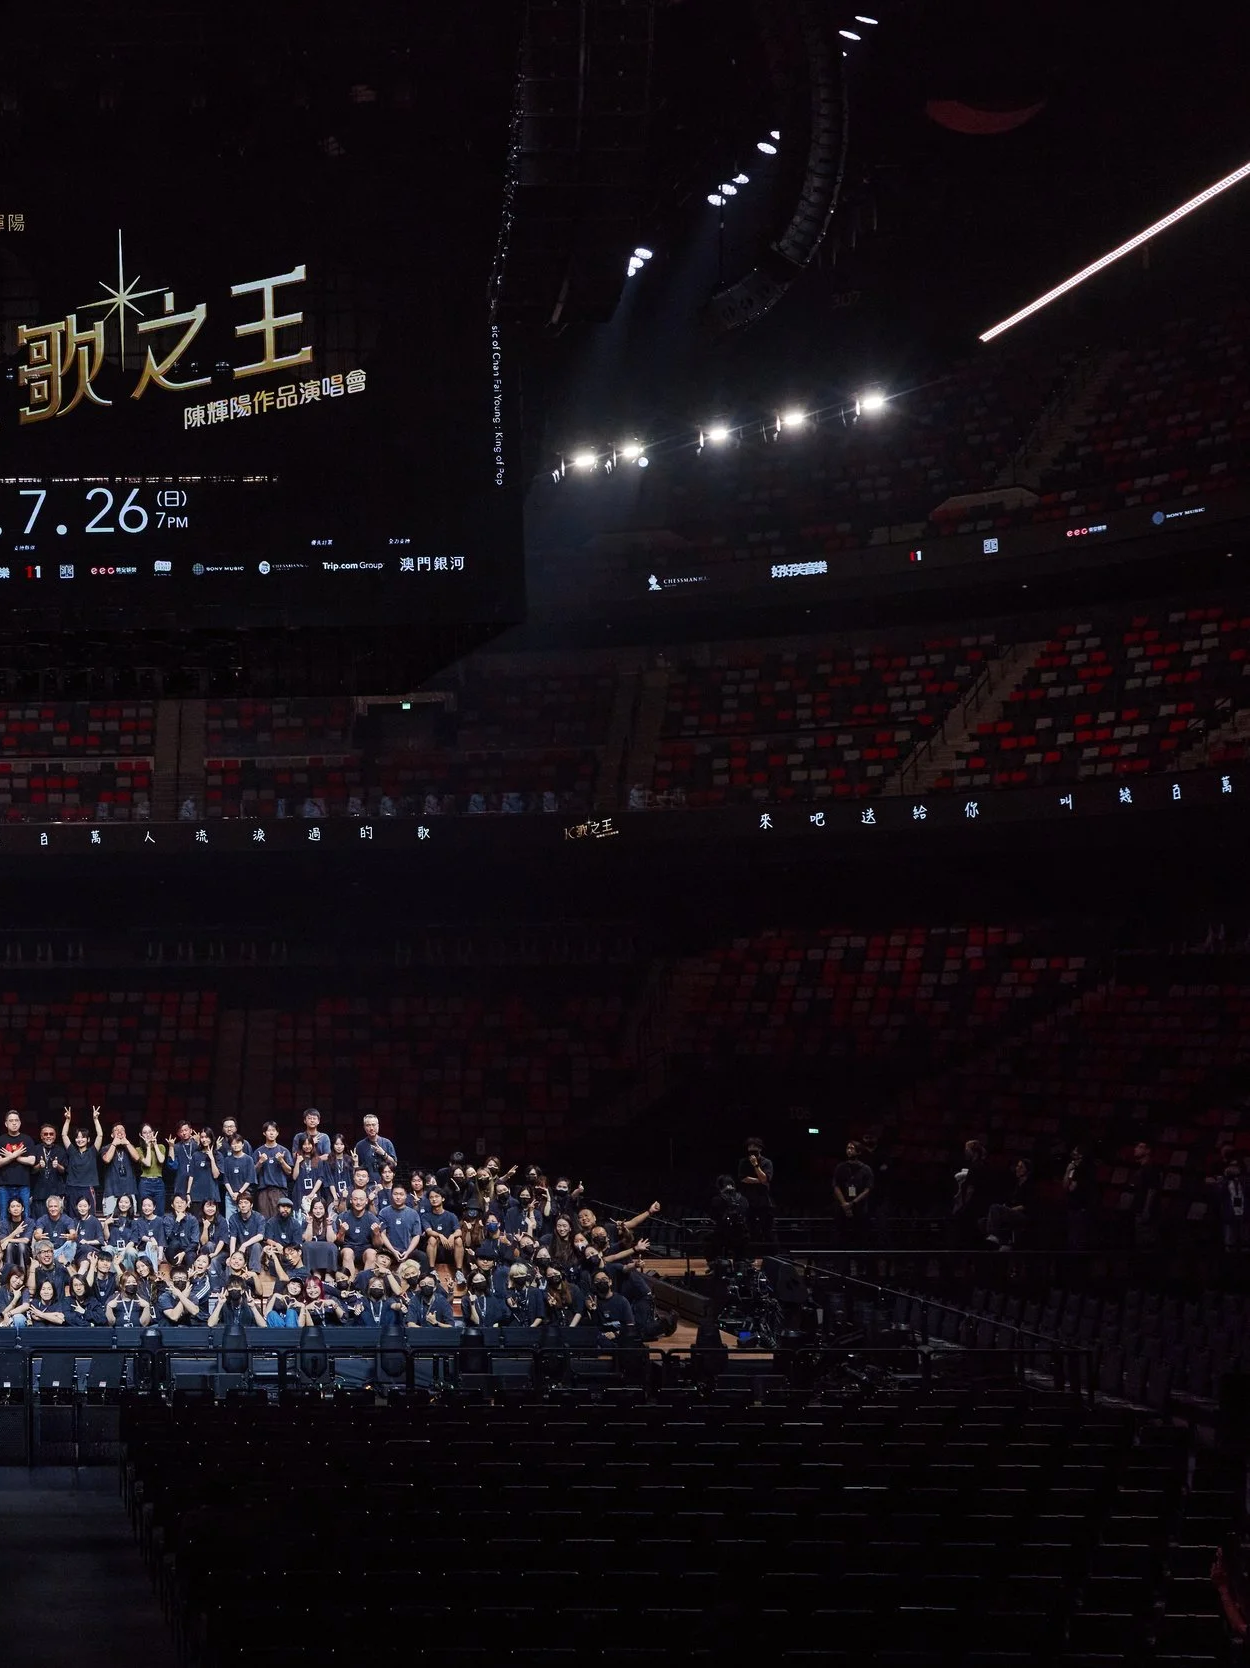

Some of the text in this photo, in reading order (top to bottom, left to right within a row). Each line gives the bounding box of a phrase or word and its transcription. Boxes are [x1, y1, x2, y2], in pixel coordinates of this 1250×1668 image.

[492, 340, 501, 350] of
[492, 352, 501, 376] Chan
[493, 379, 502, 392] Fai
[183, 368, 367, 430] 陳輝陽作品演唱會
[492, 394, 503, 423] Young
[493, 432, 503, 453] King
[495, 455, 505, 465] of
[155, 511, 189, 529] 7PM
[322, 561, 384, 572] Trip.com Group
[399, 556, 465, 572] 澳門銀河
[663, 576, 698, 585] CHESSMAN
[564, 817, 613, 841] K歌之王
